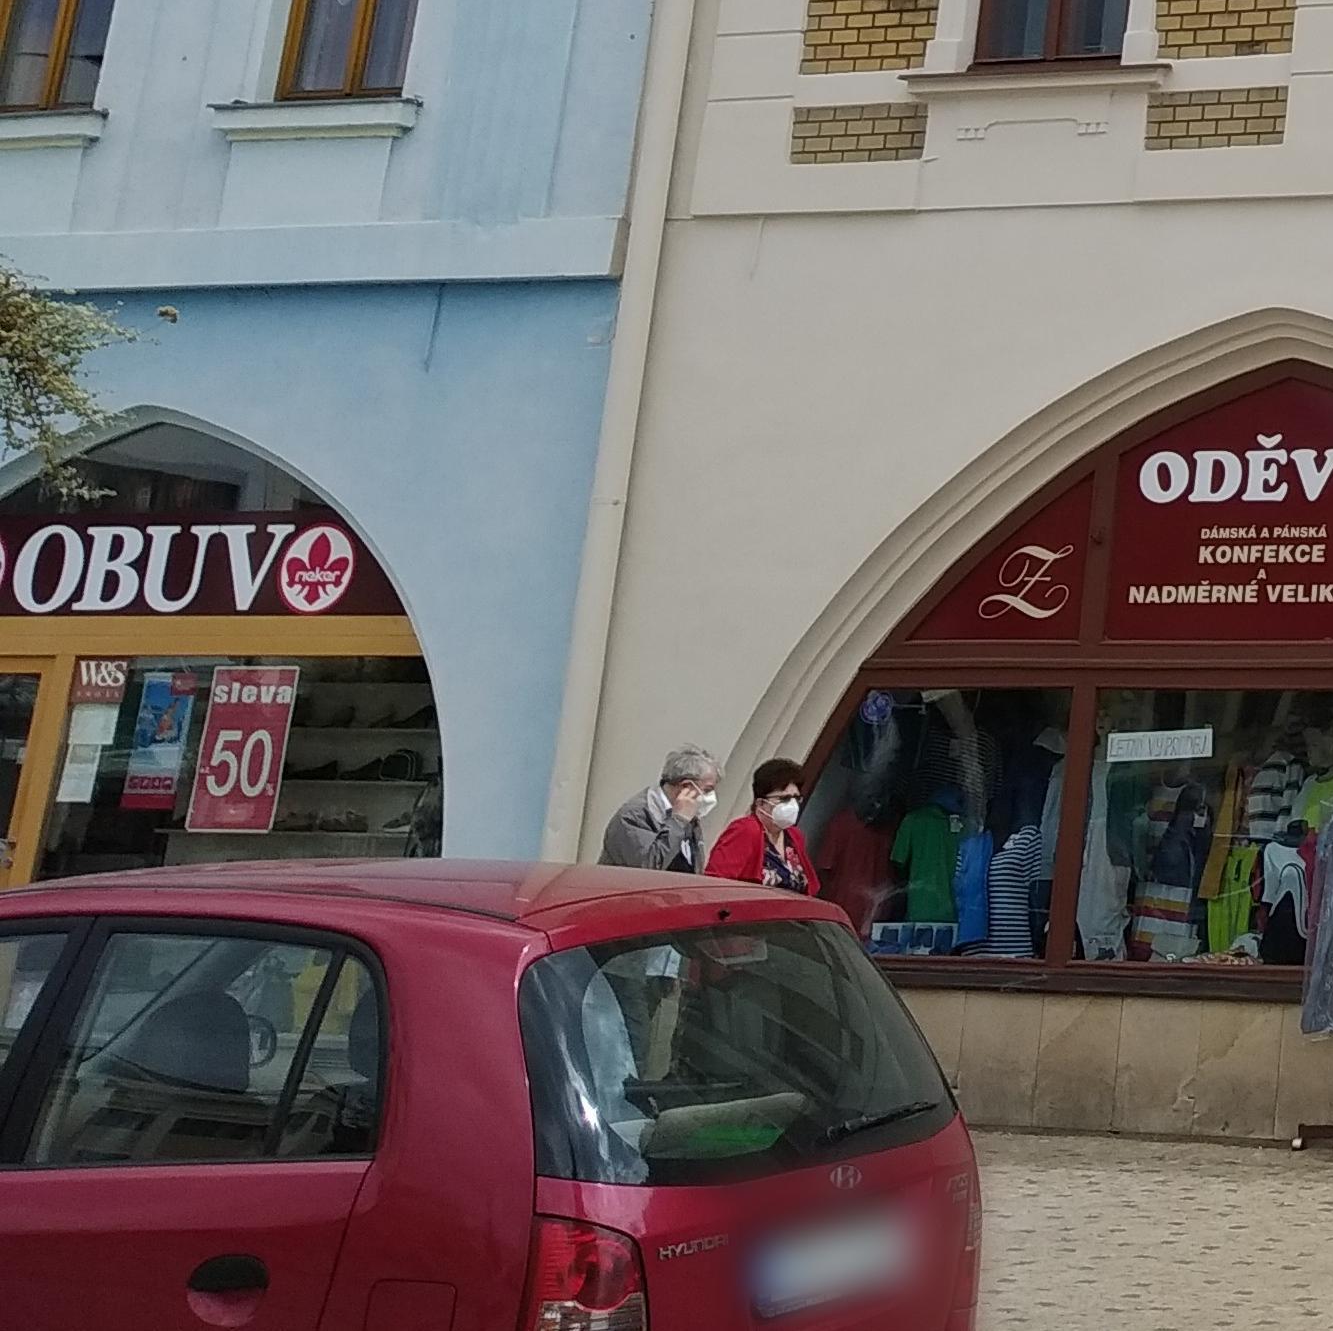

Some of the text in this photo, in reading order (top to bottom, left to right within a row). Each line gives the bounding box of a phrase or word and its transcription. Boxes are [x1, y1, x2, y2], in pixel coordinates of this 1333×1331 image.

[1200, 524, 1328, 539] DÁMSKÁ A PÁNSKÁ
[1198, 544, 1327, 564] KONFEKCE
[12, 523, 296, 614] OBUV
[1256, 568, 1268, 580] A
[1128, 579, 1259, 604] NADMĚRNÉ
[79, 660, 128, 687] W&S
[213, 681, 294, 704] sleva
[206, 728, 273, 798] 50
[657, 1233, 729, 1261] HYUNDAI
